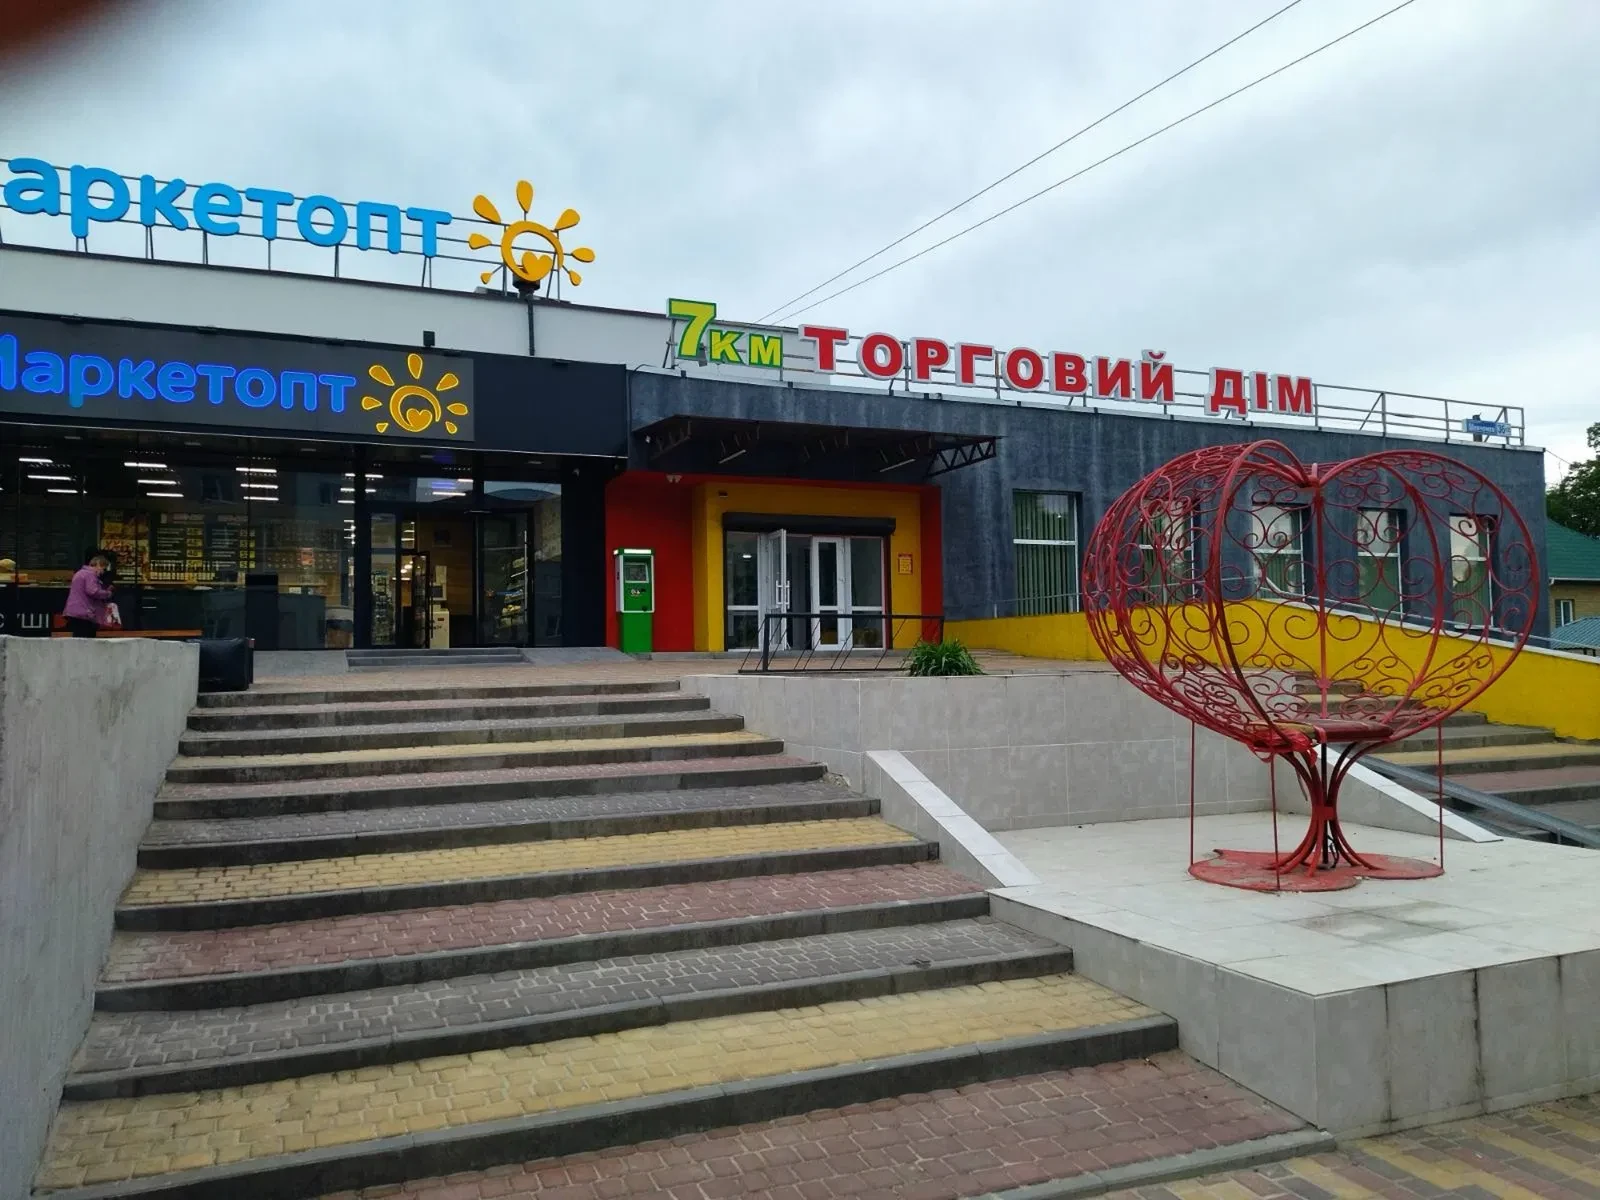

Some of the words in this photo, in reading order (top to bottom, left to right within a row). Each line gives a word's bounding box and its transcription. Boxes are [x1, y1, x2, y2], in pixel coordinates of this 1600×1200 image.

[3, 157, 452, 257] аркетопт
[800, 324, 1175, 402] ТОРГОВИЙ
[1205, 366, 1315, 416] ДІМ
